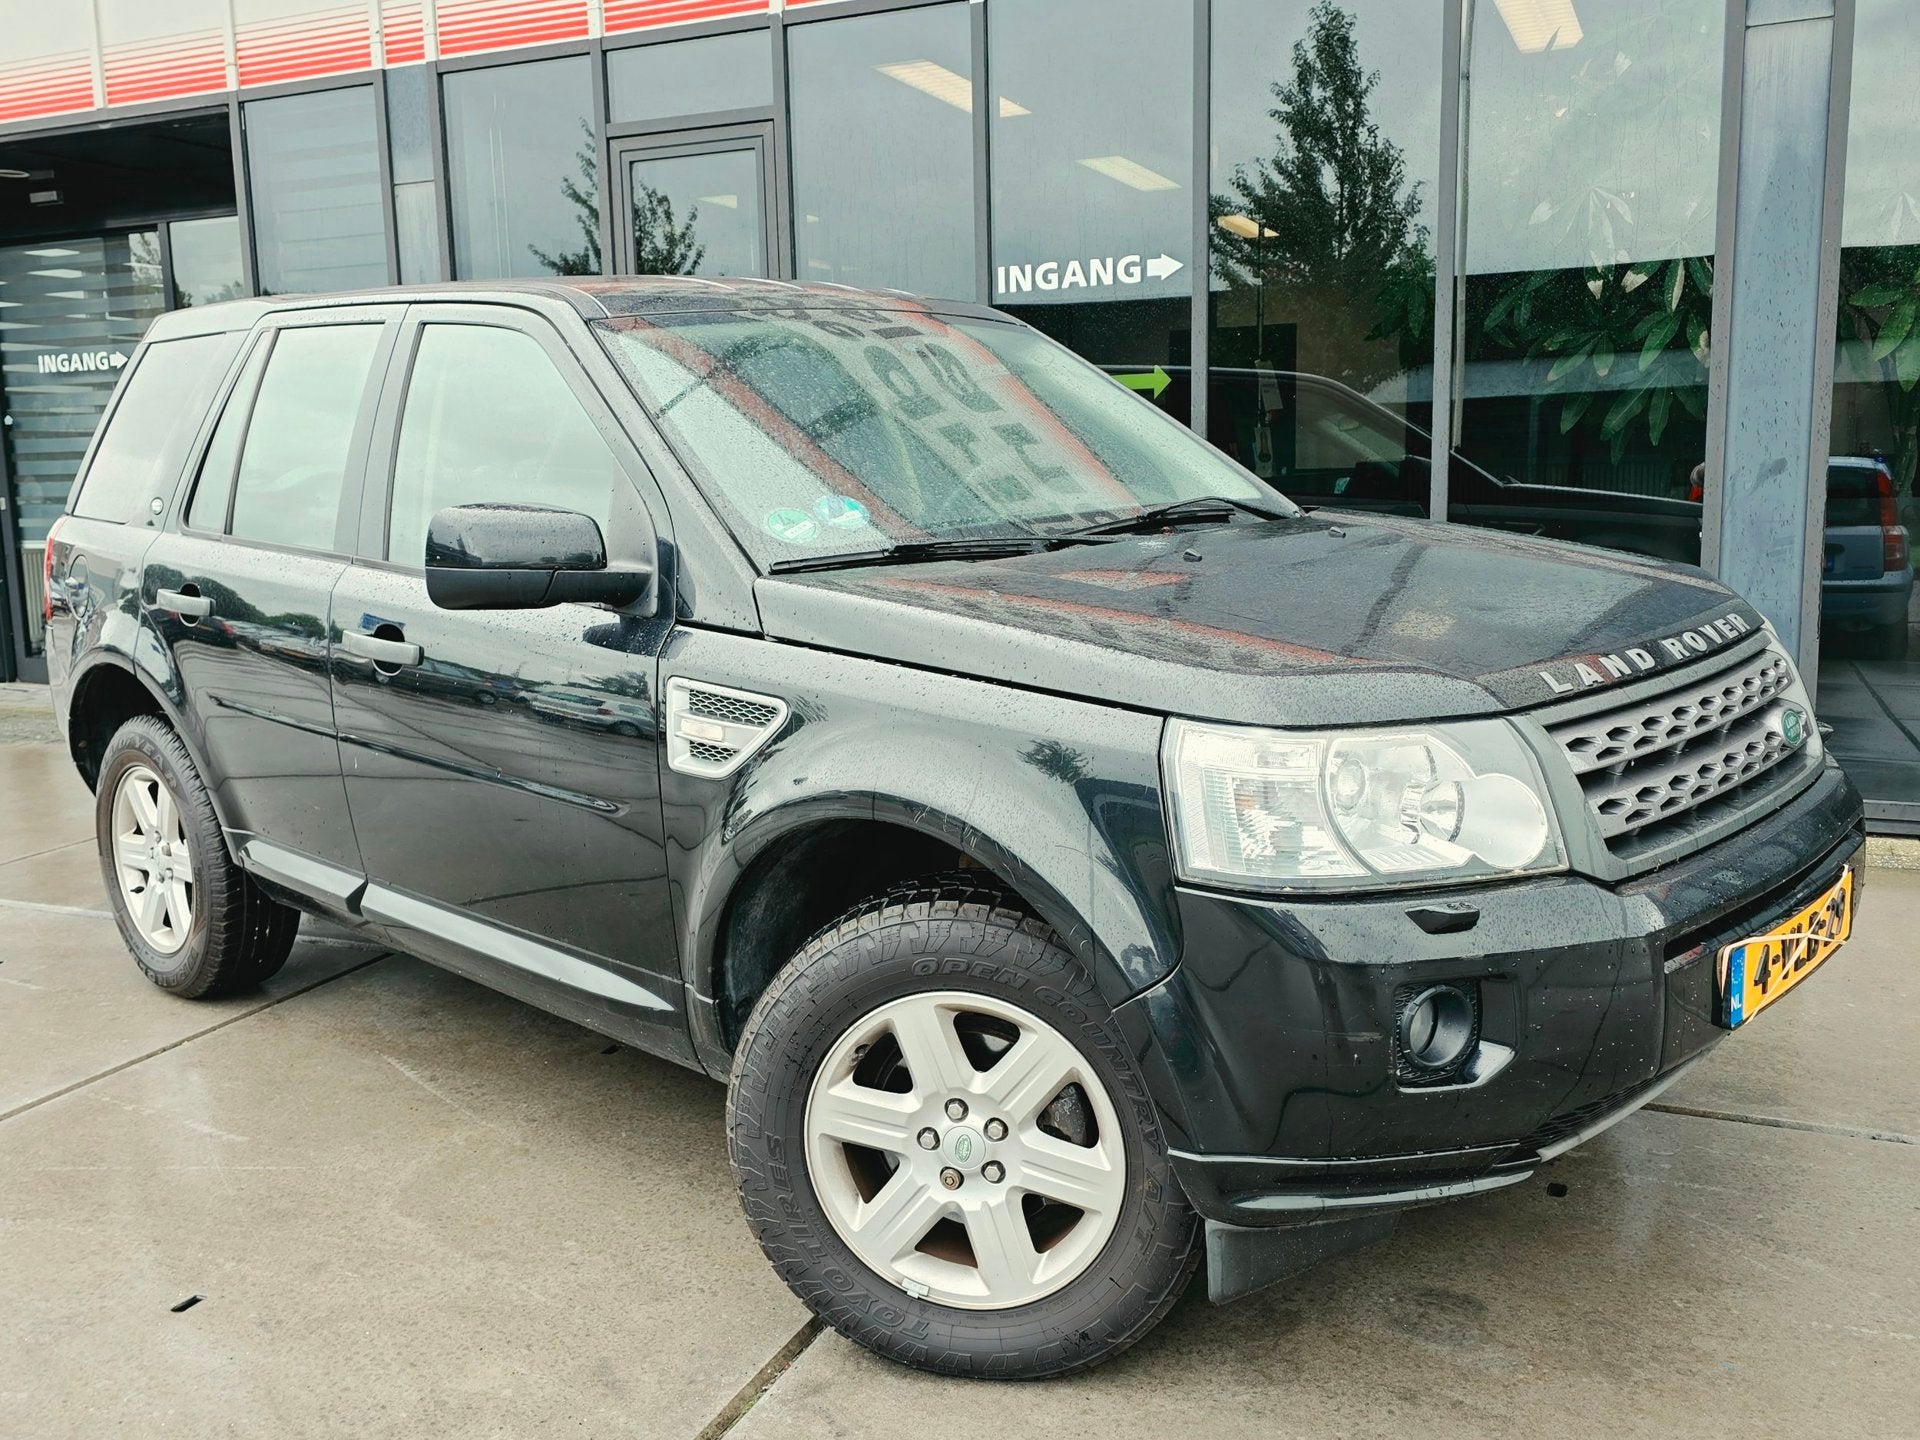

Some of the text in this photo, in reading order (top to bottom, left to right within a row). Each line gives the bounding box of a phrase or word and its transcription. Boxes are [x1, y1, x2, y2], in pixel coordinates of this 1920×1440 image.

[997, 254, 1141, 294] INGANG
[37, 351, 109, 374] INGANG
[1539, 613, 1750, 694] LAND ROVER
[1731, 994, 1742, 1013] NL
[911, 958, 1030, 990] OPEN
[1033, 986, 1162, 1156] COUNTRY
[765, 1131, 828, 1265] TIRES
[823, 1266, 931, 1340] TOYO
